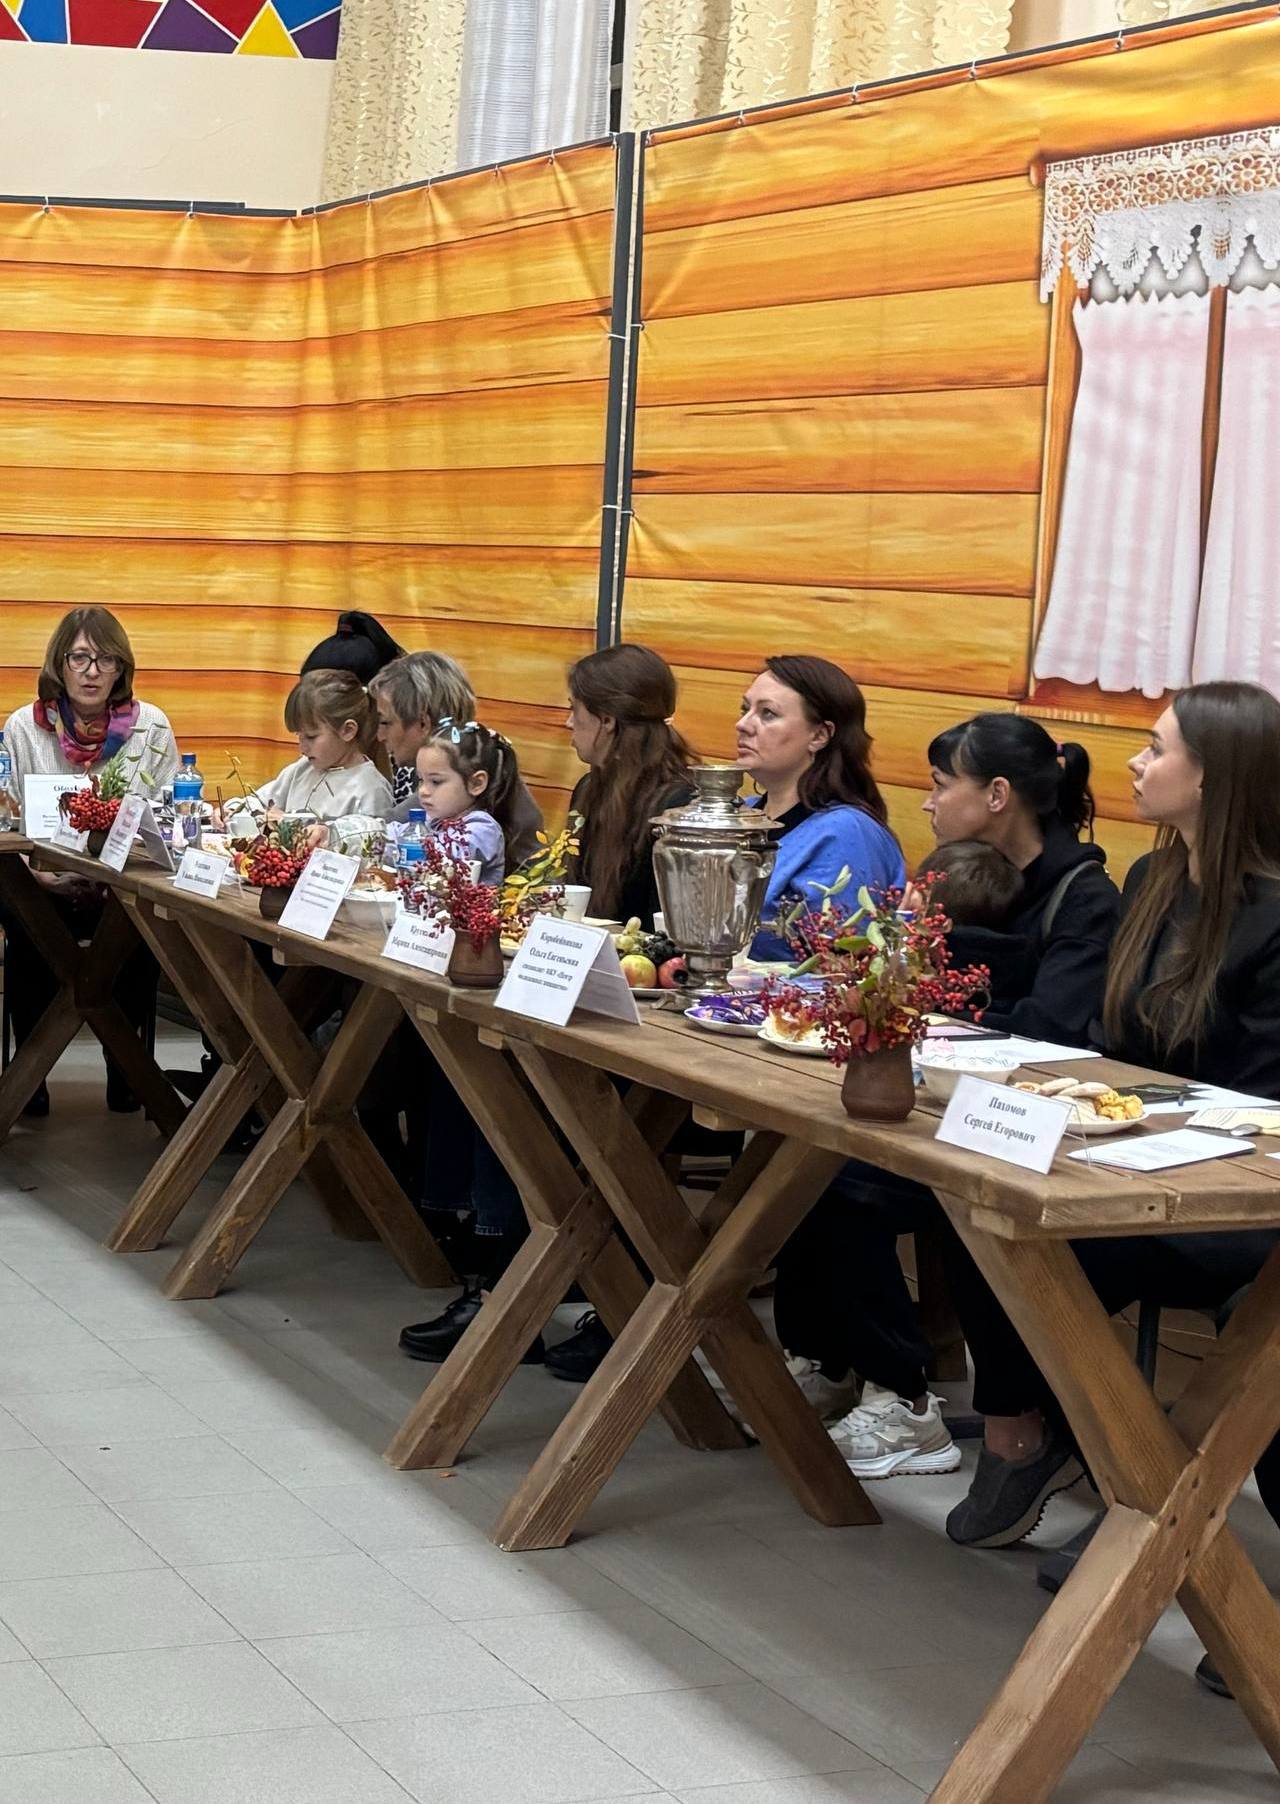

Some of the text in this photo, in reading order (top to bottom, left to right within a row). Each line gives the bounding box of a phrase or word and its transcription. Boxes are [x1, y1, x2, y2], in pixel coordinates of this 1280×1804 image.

[988, 1096, 1028, 1116] Пахомов
[964, 1113, 1036, 1144] Сергей Егорович
